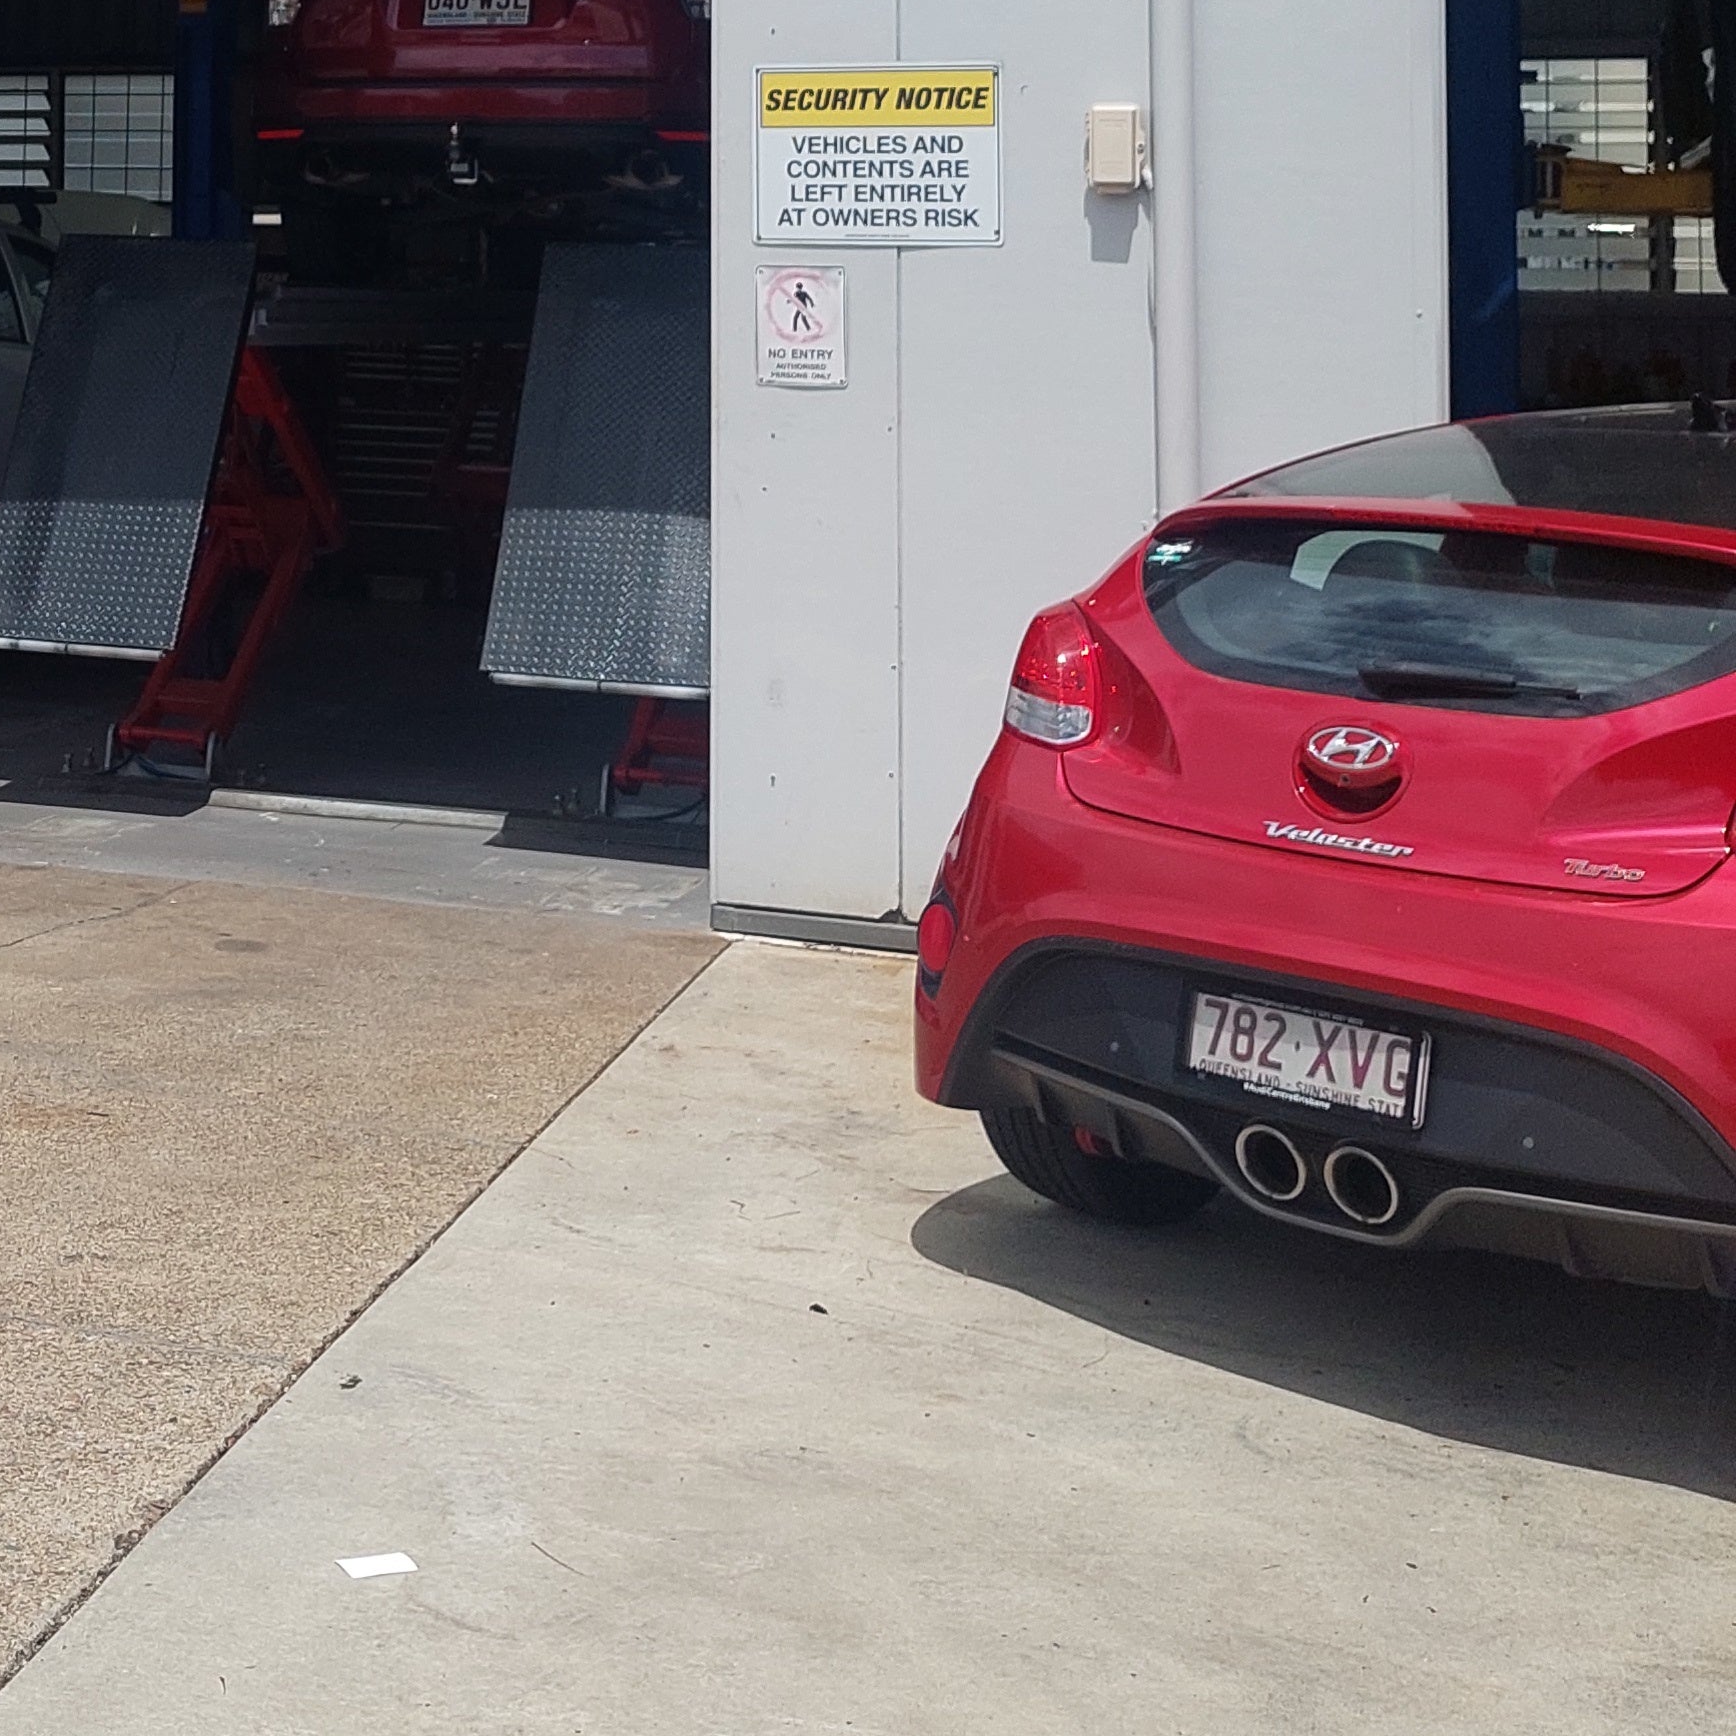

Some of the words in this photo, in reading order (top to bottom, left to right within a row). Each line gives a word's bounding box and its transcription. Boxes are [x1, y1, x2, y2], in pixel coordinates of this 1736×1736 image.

[766, 88, 890, 111] SECURITY
[895, 86, 990, 110] NOTICE
[792, 135, 907, 154] VEHICLES
[913, 135, 964, 154] AND
[787, 159, 914, 178] CONTENTS
[919, 159, 970, 178] ARE
[790, 183, 848, 202] LEFT
[854, 183, 967, 202] ENTIRELY
[777, 207, 807, 226] AT
[812, 207, 918, 227] OWNERS
[924, 207, 979, 227] RISK
[768, 347, 786, 359] NO
[791, 348, 833, 360] ENTRY
[1264, 820, 1415, 858] Veloster
[1563, 857, 1646, 883] Turbo
